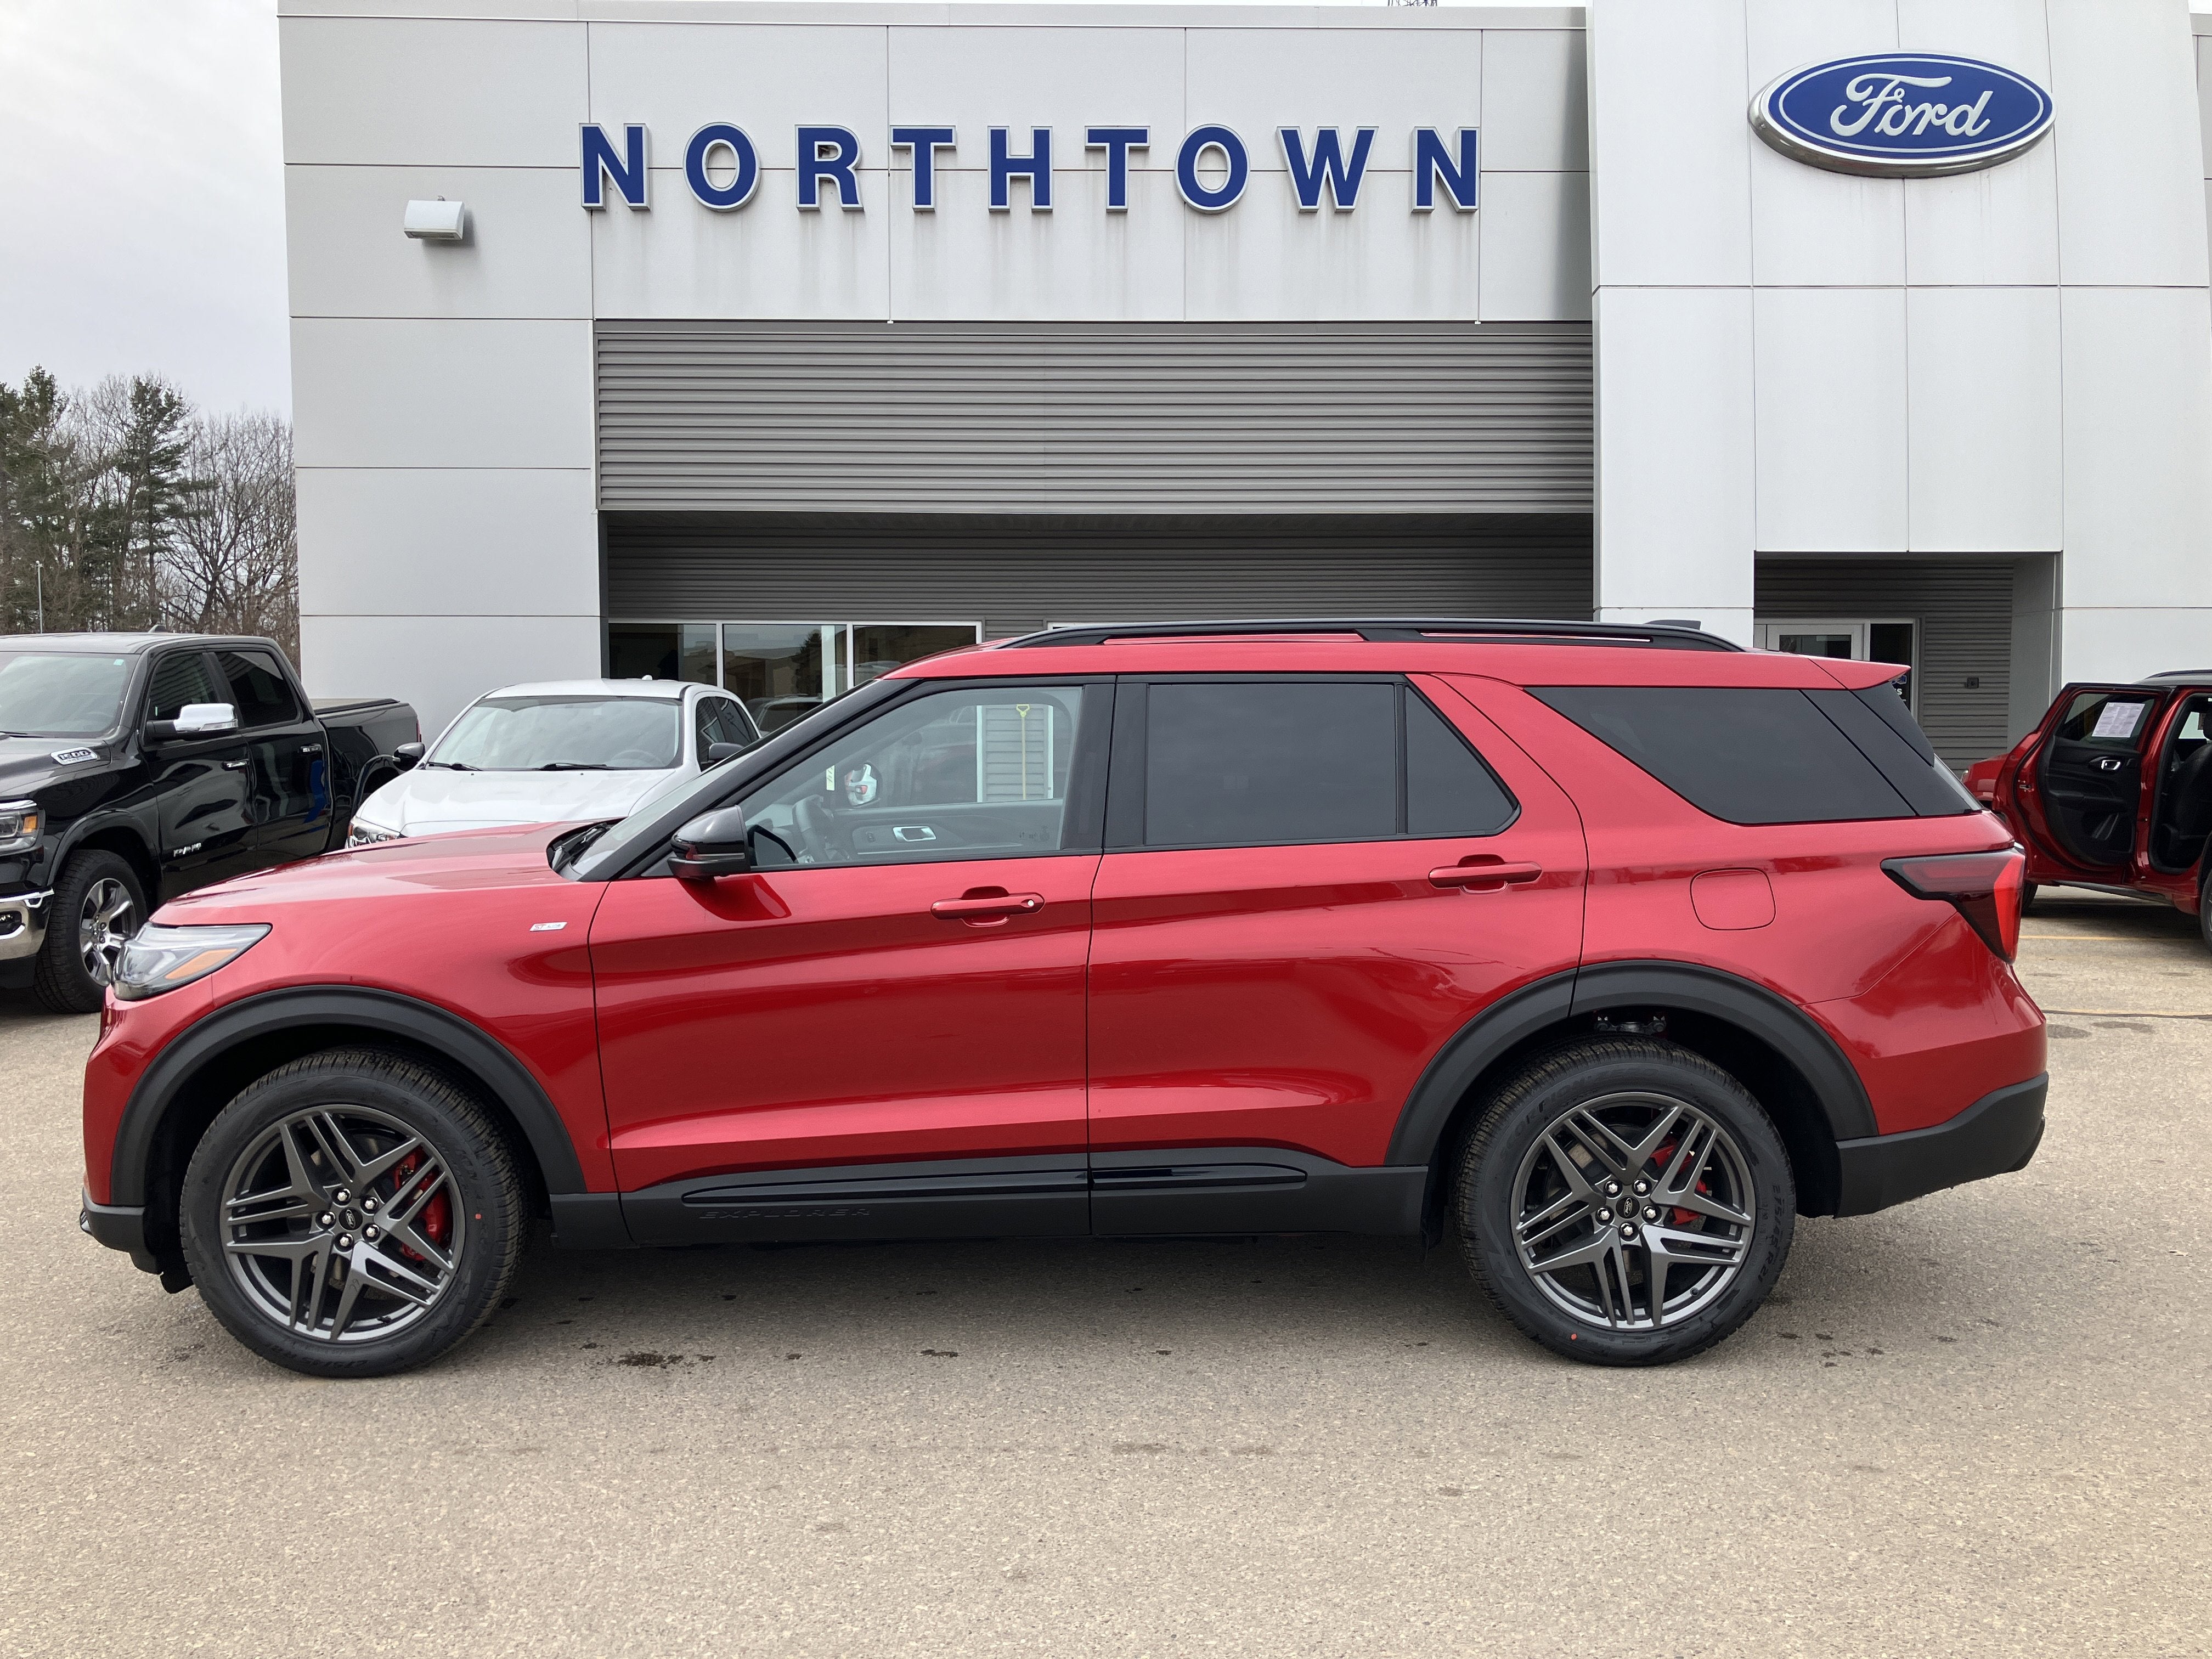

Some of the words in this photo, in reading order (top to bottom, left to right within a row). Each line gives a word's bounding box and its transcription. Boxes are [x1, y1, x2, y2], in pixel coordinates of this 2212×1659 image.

[1830, 73, 1994, 137] Ford
[579, 122, 1480, 213] NORTHTOWN
[58, 750, 91, 760] 1500
[698, 1208, 871, 1219] EXPLORER
